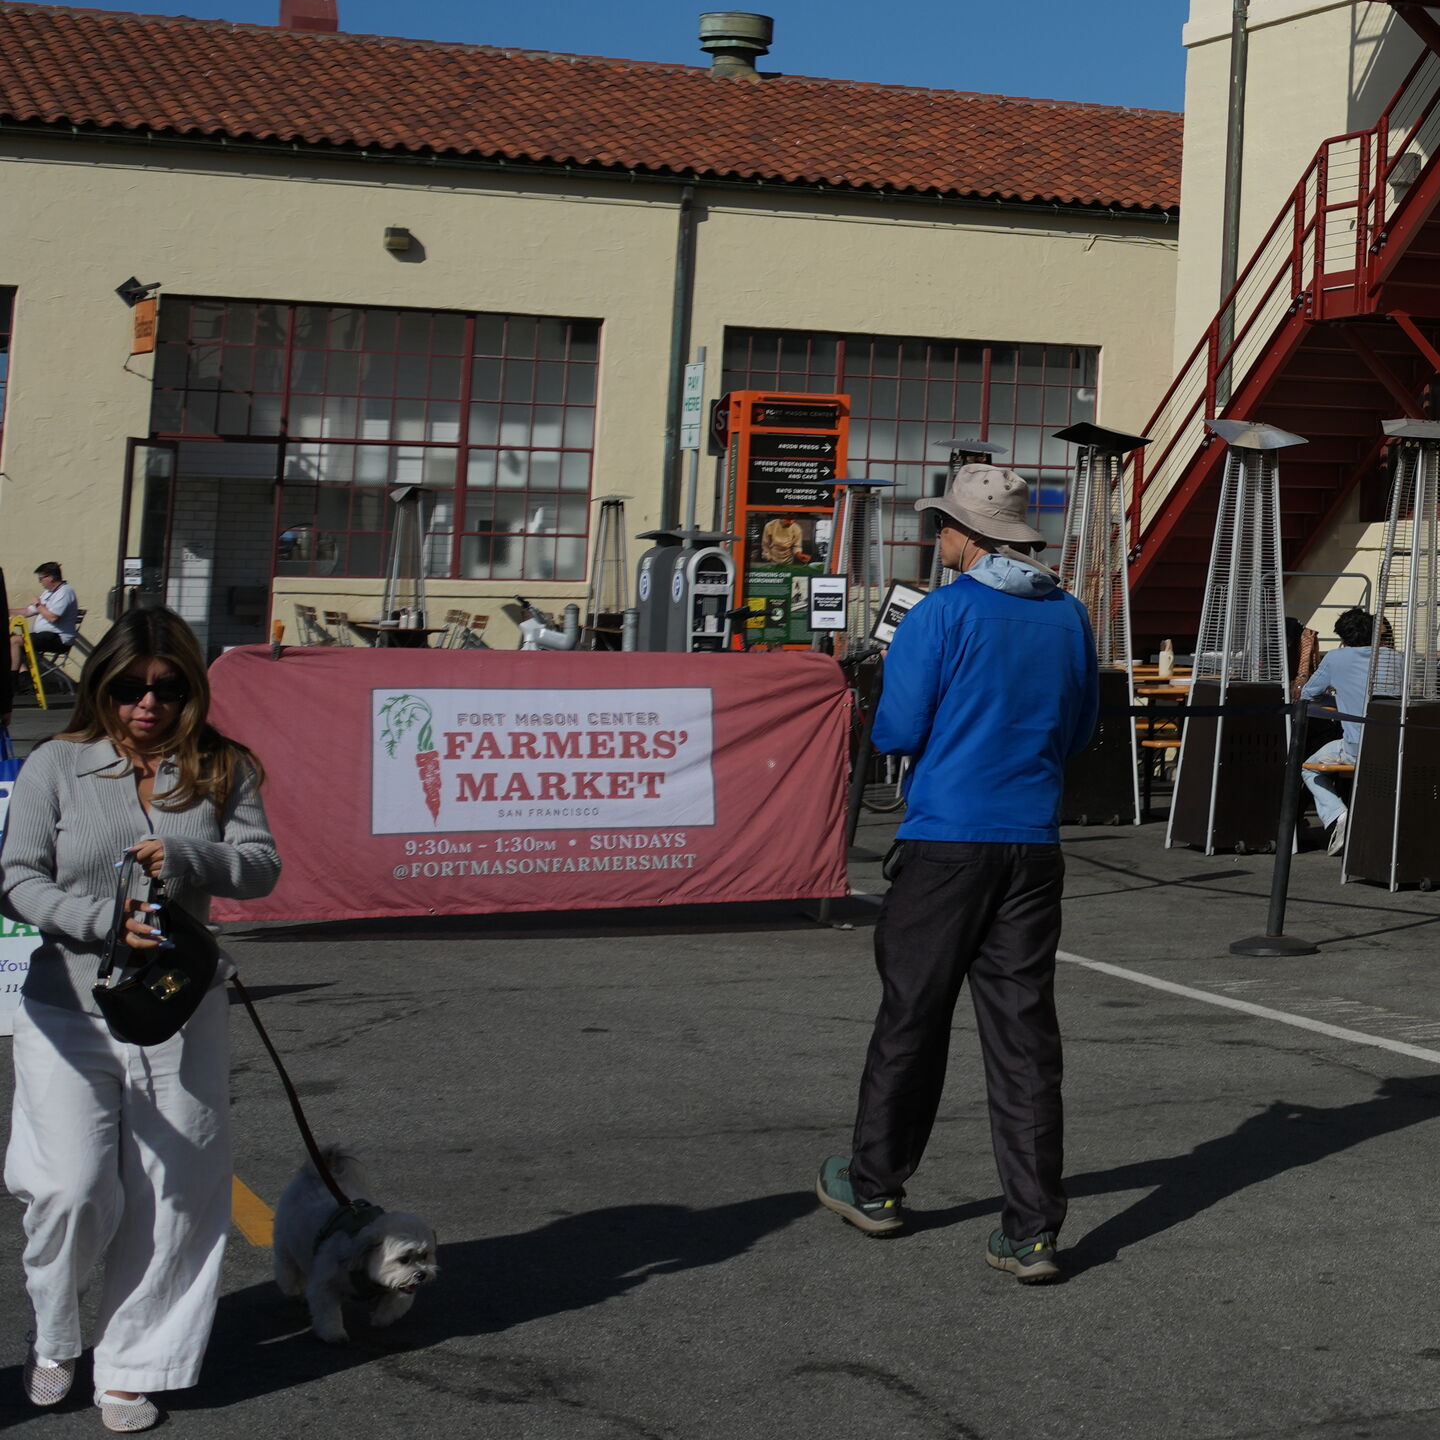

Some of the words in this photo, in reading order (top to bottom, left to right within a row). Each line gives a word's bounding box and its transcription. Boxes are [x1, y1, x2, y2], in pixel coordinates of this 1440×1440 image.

[457, 713, 506, 726] FORT
[515, 713, 579, 726] MASON
[587, 712, 660, 726] CENTER
[455, 771, 666, 802] MARKET
[498, 809, 522, 818] SAN
[528, 807, 600, 817] FRANCISCO
[590, 832, 687, 851] SUNDAYS
[392, 853, 697, 881] @FORTMASONFARMERSMKT
